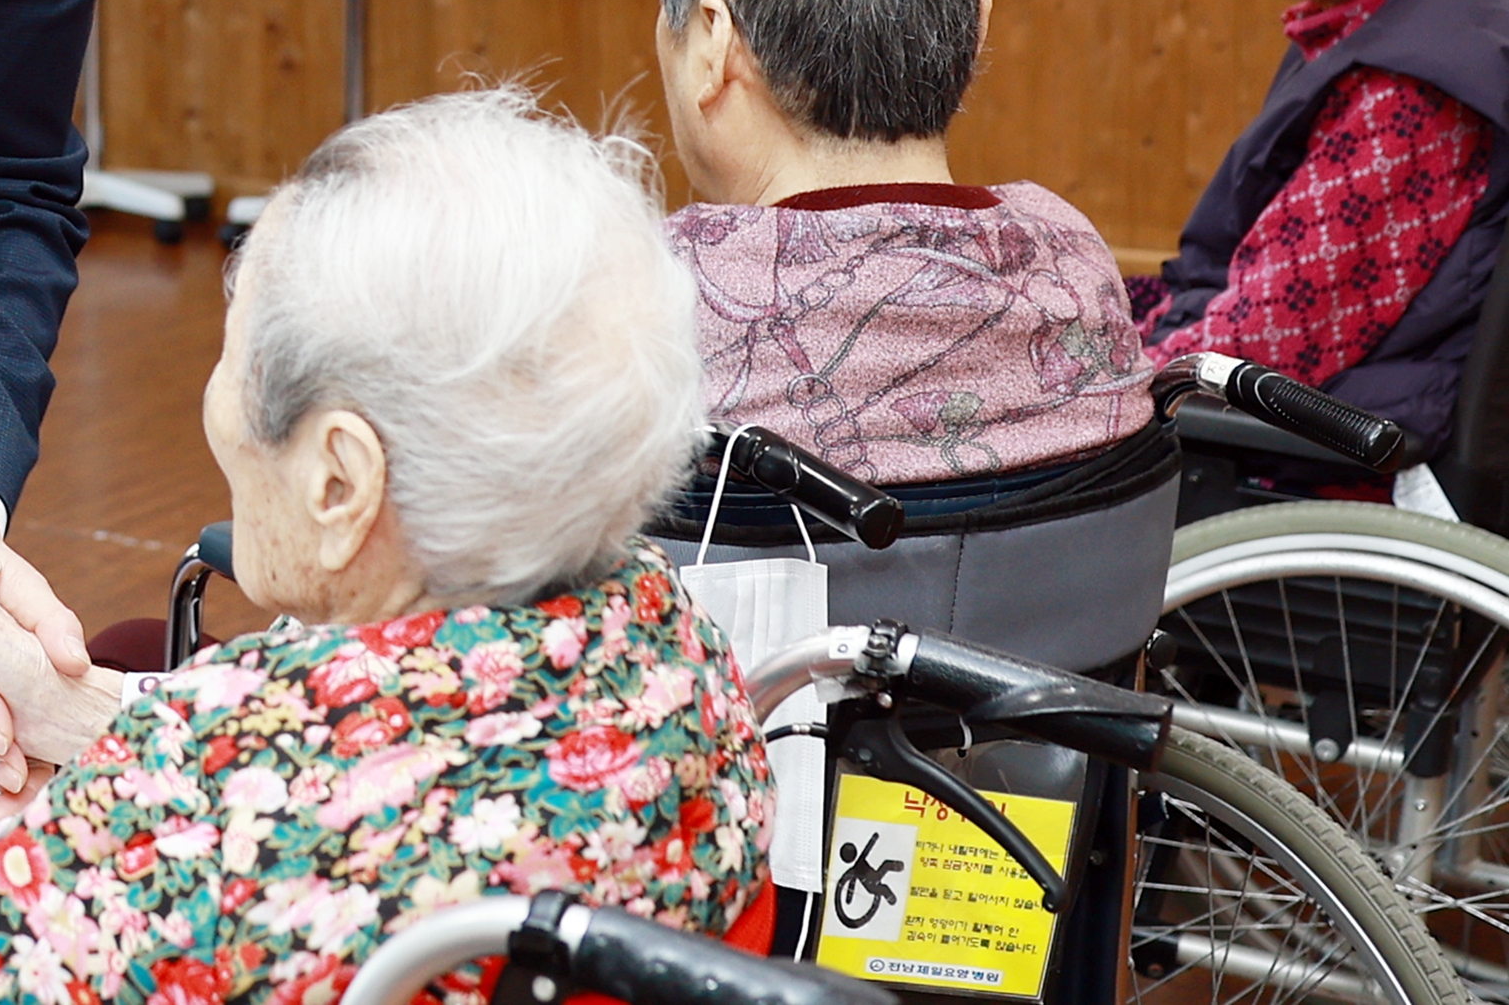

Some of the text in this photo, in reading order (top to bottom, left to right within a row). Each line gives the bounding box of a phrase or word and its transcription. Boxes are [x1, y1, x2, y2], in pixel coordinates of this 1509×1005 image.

[904, 791, 1006, 822] 낙상
[943, 859, 993, 874] 잠금장치를
[968, 893, 1009, 907] 일어서지
[1014, 898, 1043, 911] 않습니
[905, 915, 924, 927] 환자
[929, 918, 967, 931] 엉덩이가
[973, 922, 1003, 936] 휠체어
[941, 934, 990, 948] 들어가도록
